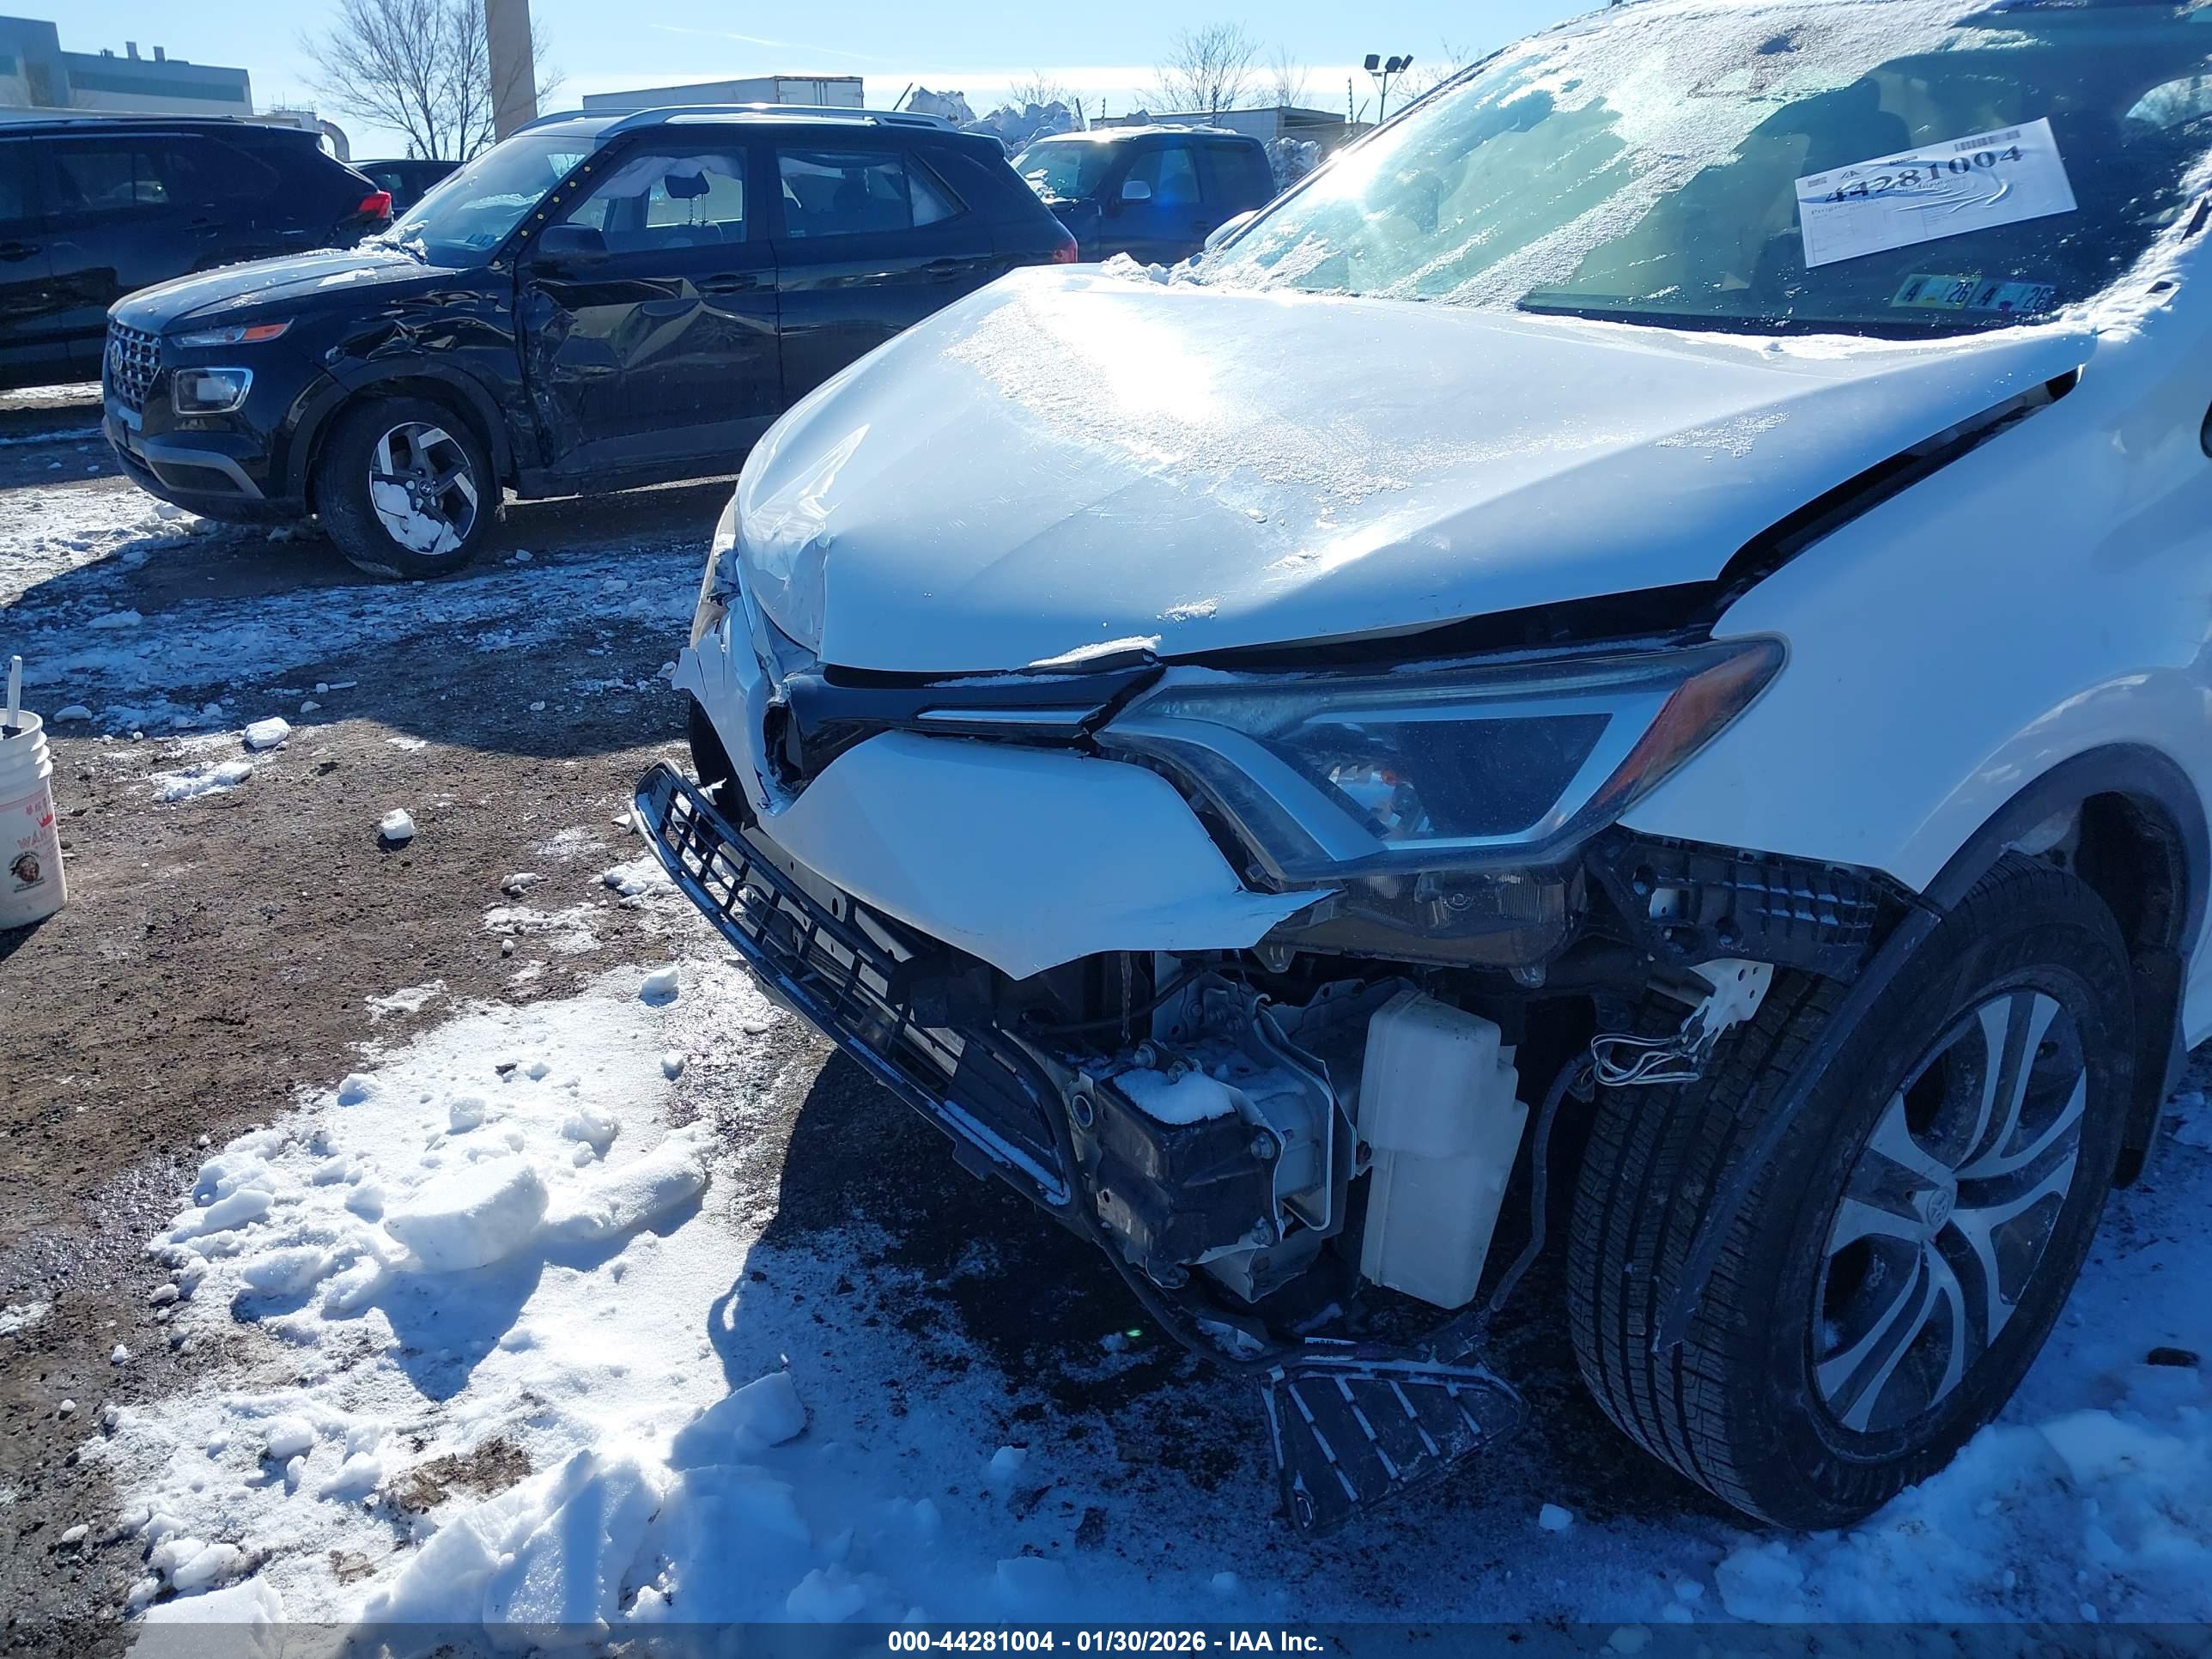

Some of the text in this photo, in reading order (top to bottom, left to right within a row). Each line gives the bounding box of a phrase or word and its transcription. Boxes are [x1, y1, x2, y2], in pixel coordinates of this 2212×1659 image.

[1826, 145, 2023, 202] 44281004
[1905, 281, 1973, 304] 4 26
[1978, 285, 2050, 310] 4 26
